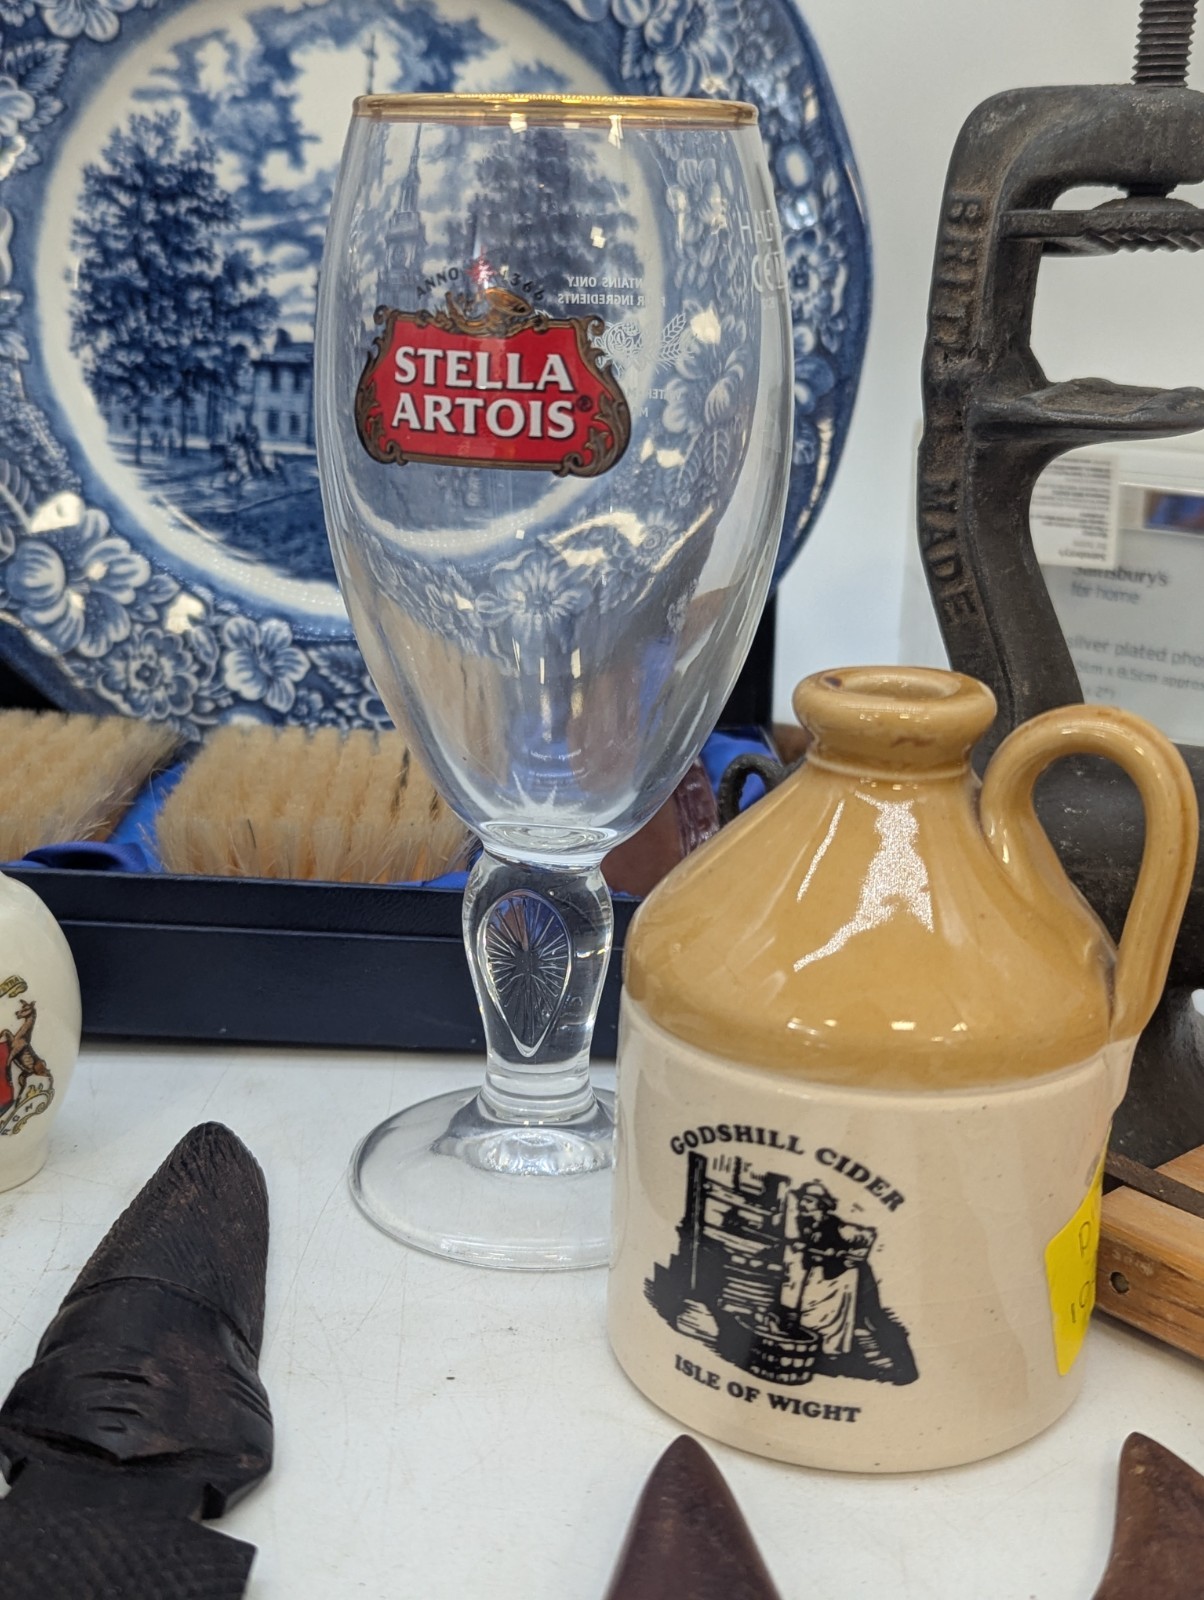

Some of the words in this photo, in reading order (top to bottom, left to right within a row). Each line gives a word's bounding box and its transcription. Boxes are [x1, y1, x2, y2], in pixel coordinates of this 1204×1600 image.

[416, 267, 459, 298] ANNO
[394, 346, 574, 392] STELLA
[391, 393, 575, 439] ARTOIS
[1096, 583, 1140, 604] home
[1114, 641, 1167, 663] plated
[670, 1124, 805, 1156] GODSHILL
[815, 1147, 906, 1213] CIDER
[674, 1354, 721, 1391] ISLE
[727, 1380, 760, 1403] OF
[767, 1392, 862, 1423] WIGHT
